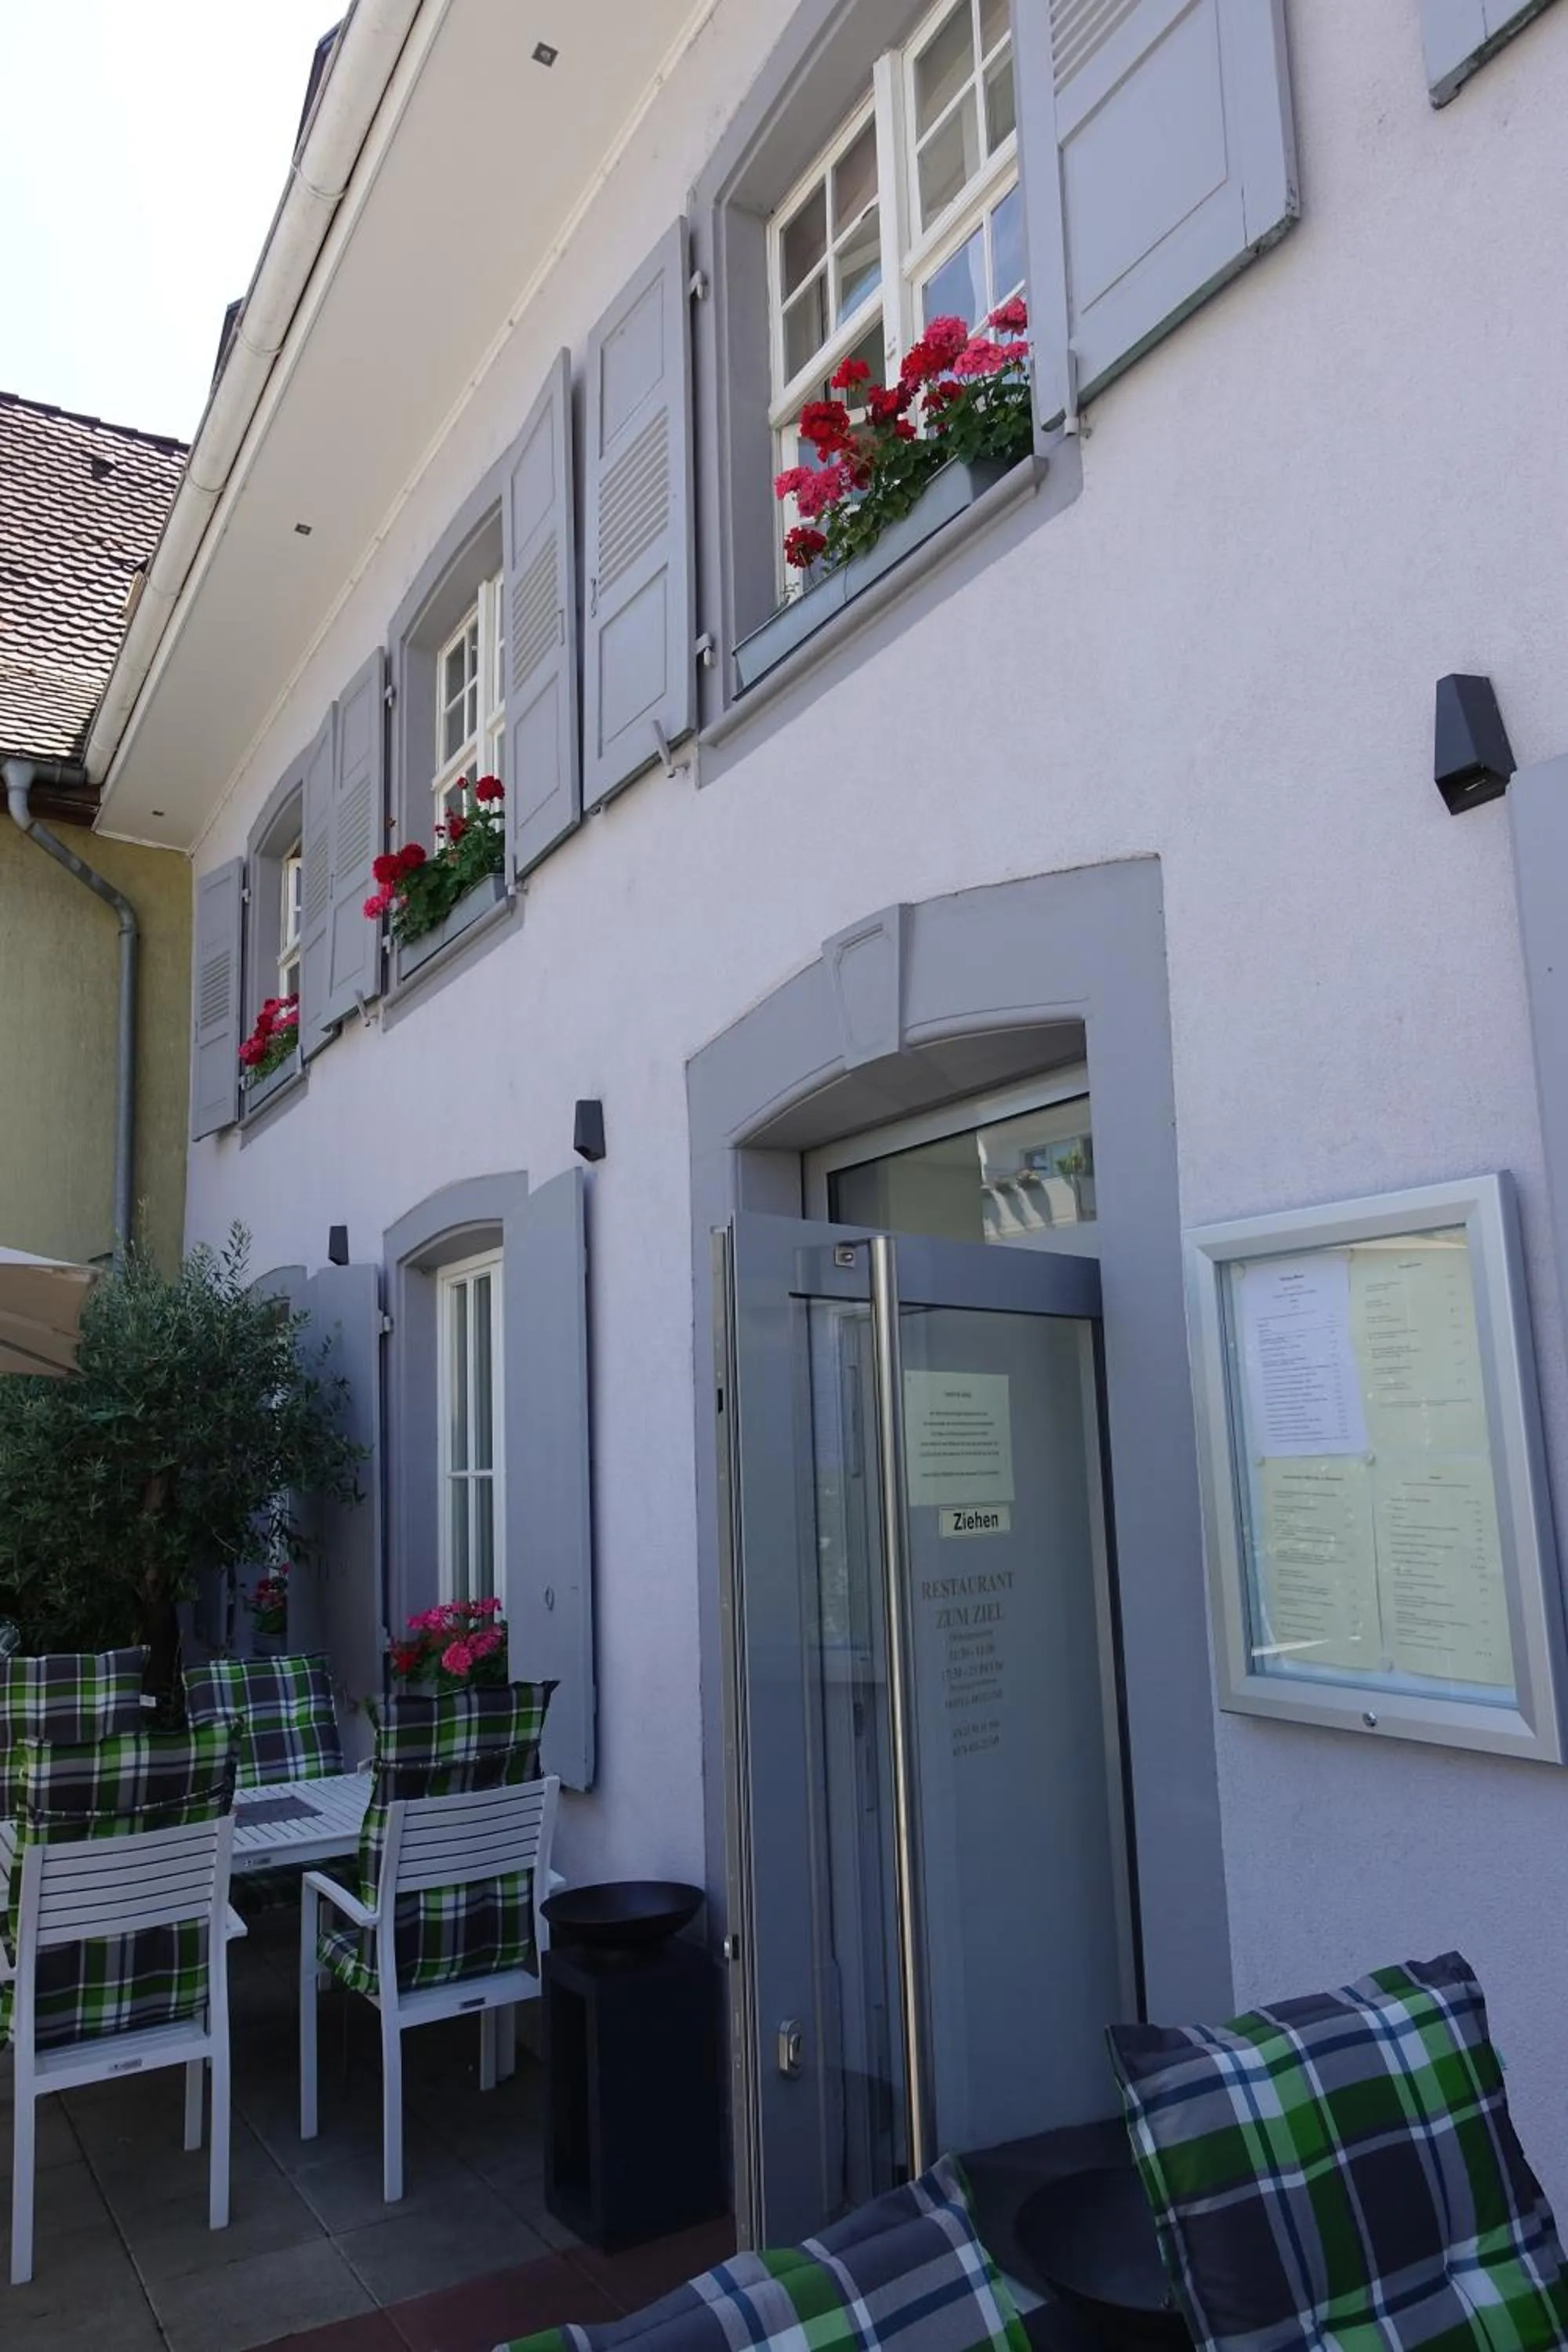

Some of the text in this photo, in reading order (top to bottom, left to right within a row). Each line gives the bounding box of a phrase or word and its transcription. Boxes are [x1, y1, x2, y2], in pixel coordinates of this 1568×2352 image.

[953, 1512, 999, 1530] Ziehen
[922, 1572, 1014, 1599] RESTAURANT
[936, 1607, 969, 1629] ZUM
